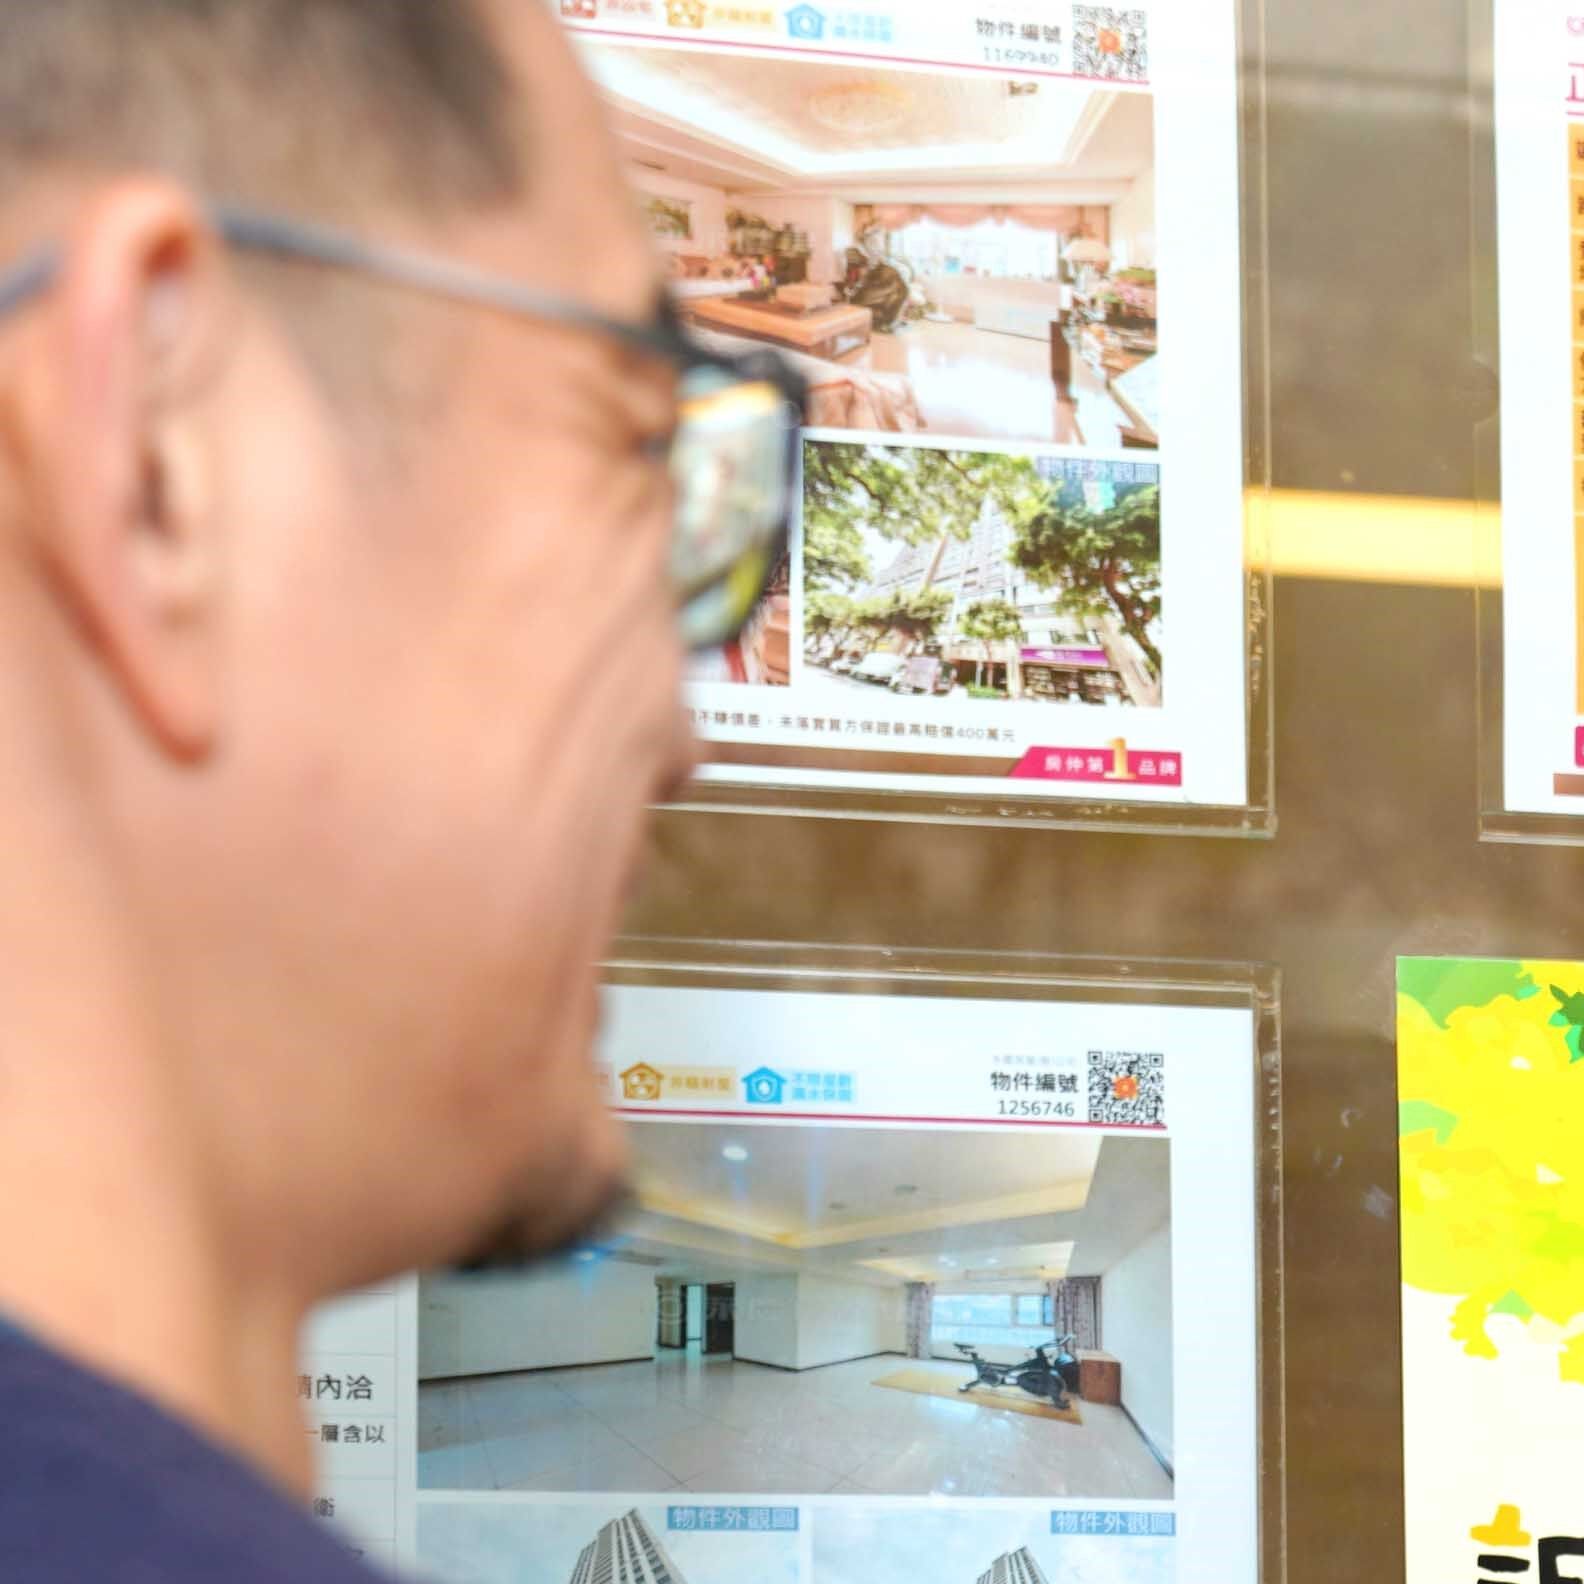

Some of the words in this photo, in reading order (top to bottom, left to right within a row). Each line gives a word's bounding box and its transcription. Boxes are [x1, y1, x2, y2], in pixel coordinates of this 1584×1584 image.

[991, 1071, 1079, 1094] 物件編號
[998, 1100, 1073, 1117] 1256746
